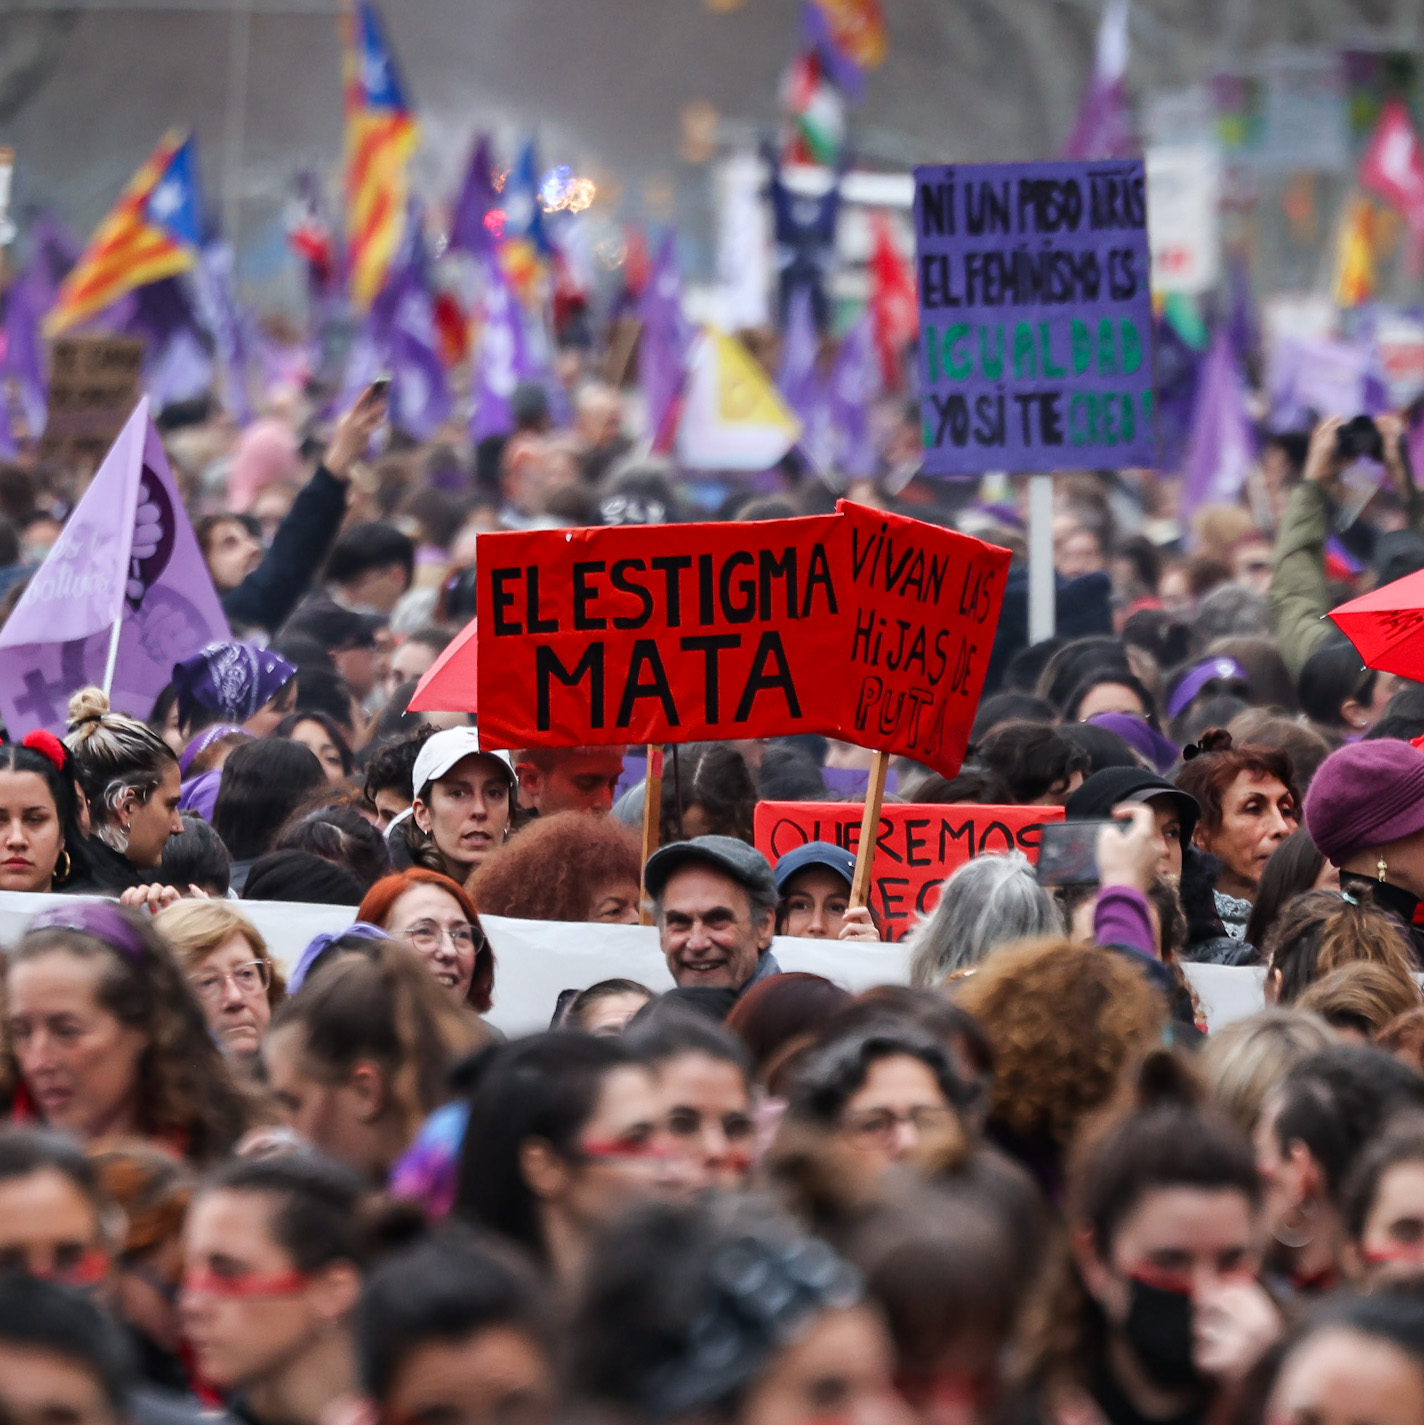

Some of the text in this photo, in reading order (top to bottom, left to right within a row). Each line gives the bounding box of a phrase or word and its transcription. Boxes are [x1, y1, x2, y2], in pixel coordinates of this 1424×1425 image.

[965, 179, 1010, 235] UN
[924, 253, 962, 309] EL
[926, 317, 1142, 384] IGUALDAD
[1013, 391, 1063, 447] TE
[491, 543, 839, 636] EL ESTIGMA
[958, 562, 995, 625] LAS
[535, 630, 803, 731] MATA
[950, 635, 977, 696] DE
[854, 675, 947, 758] PUTA
